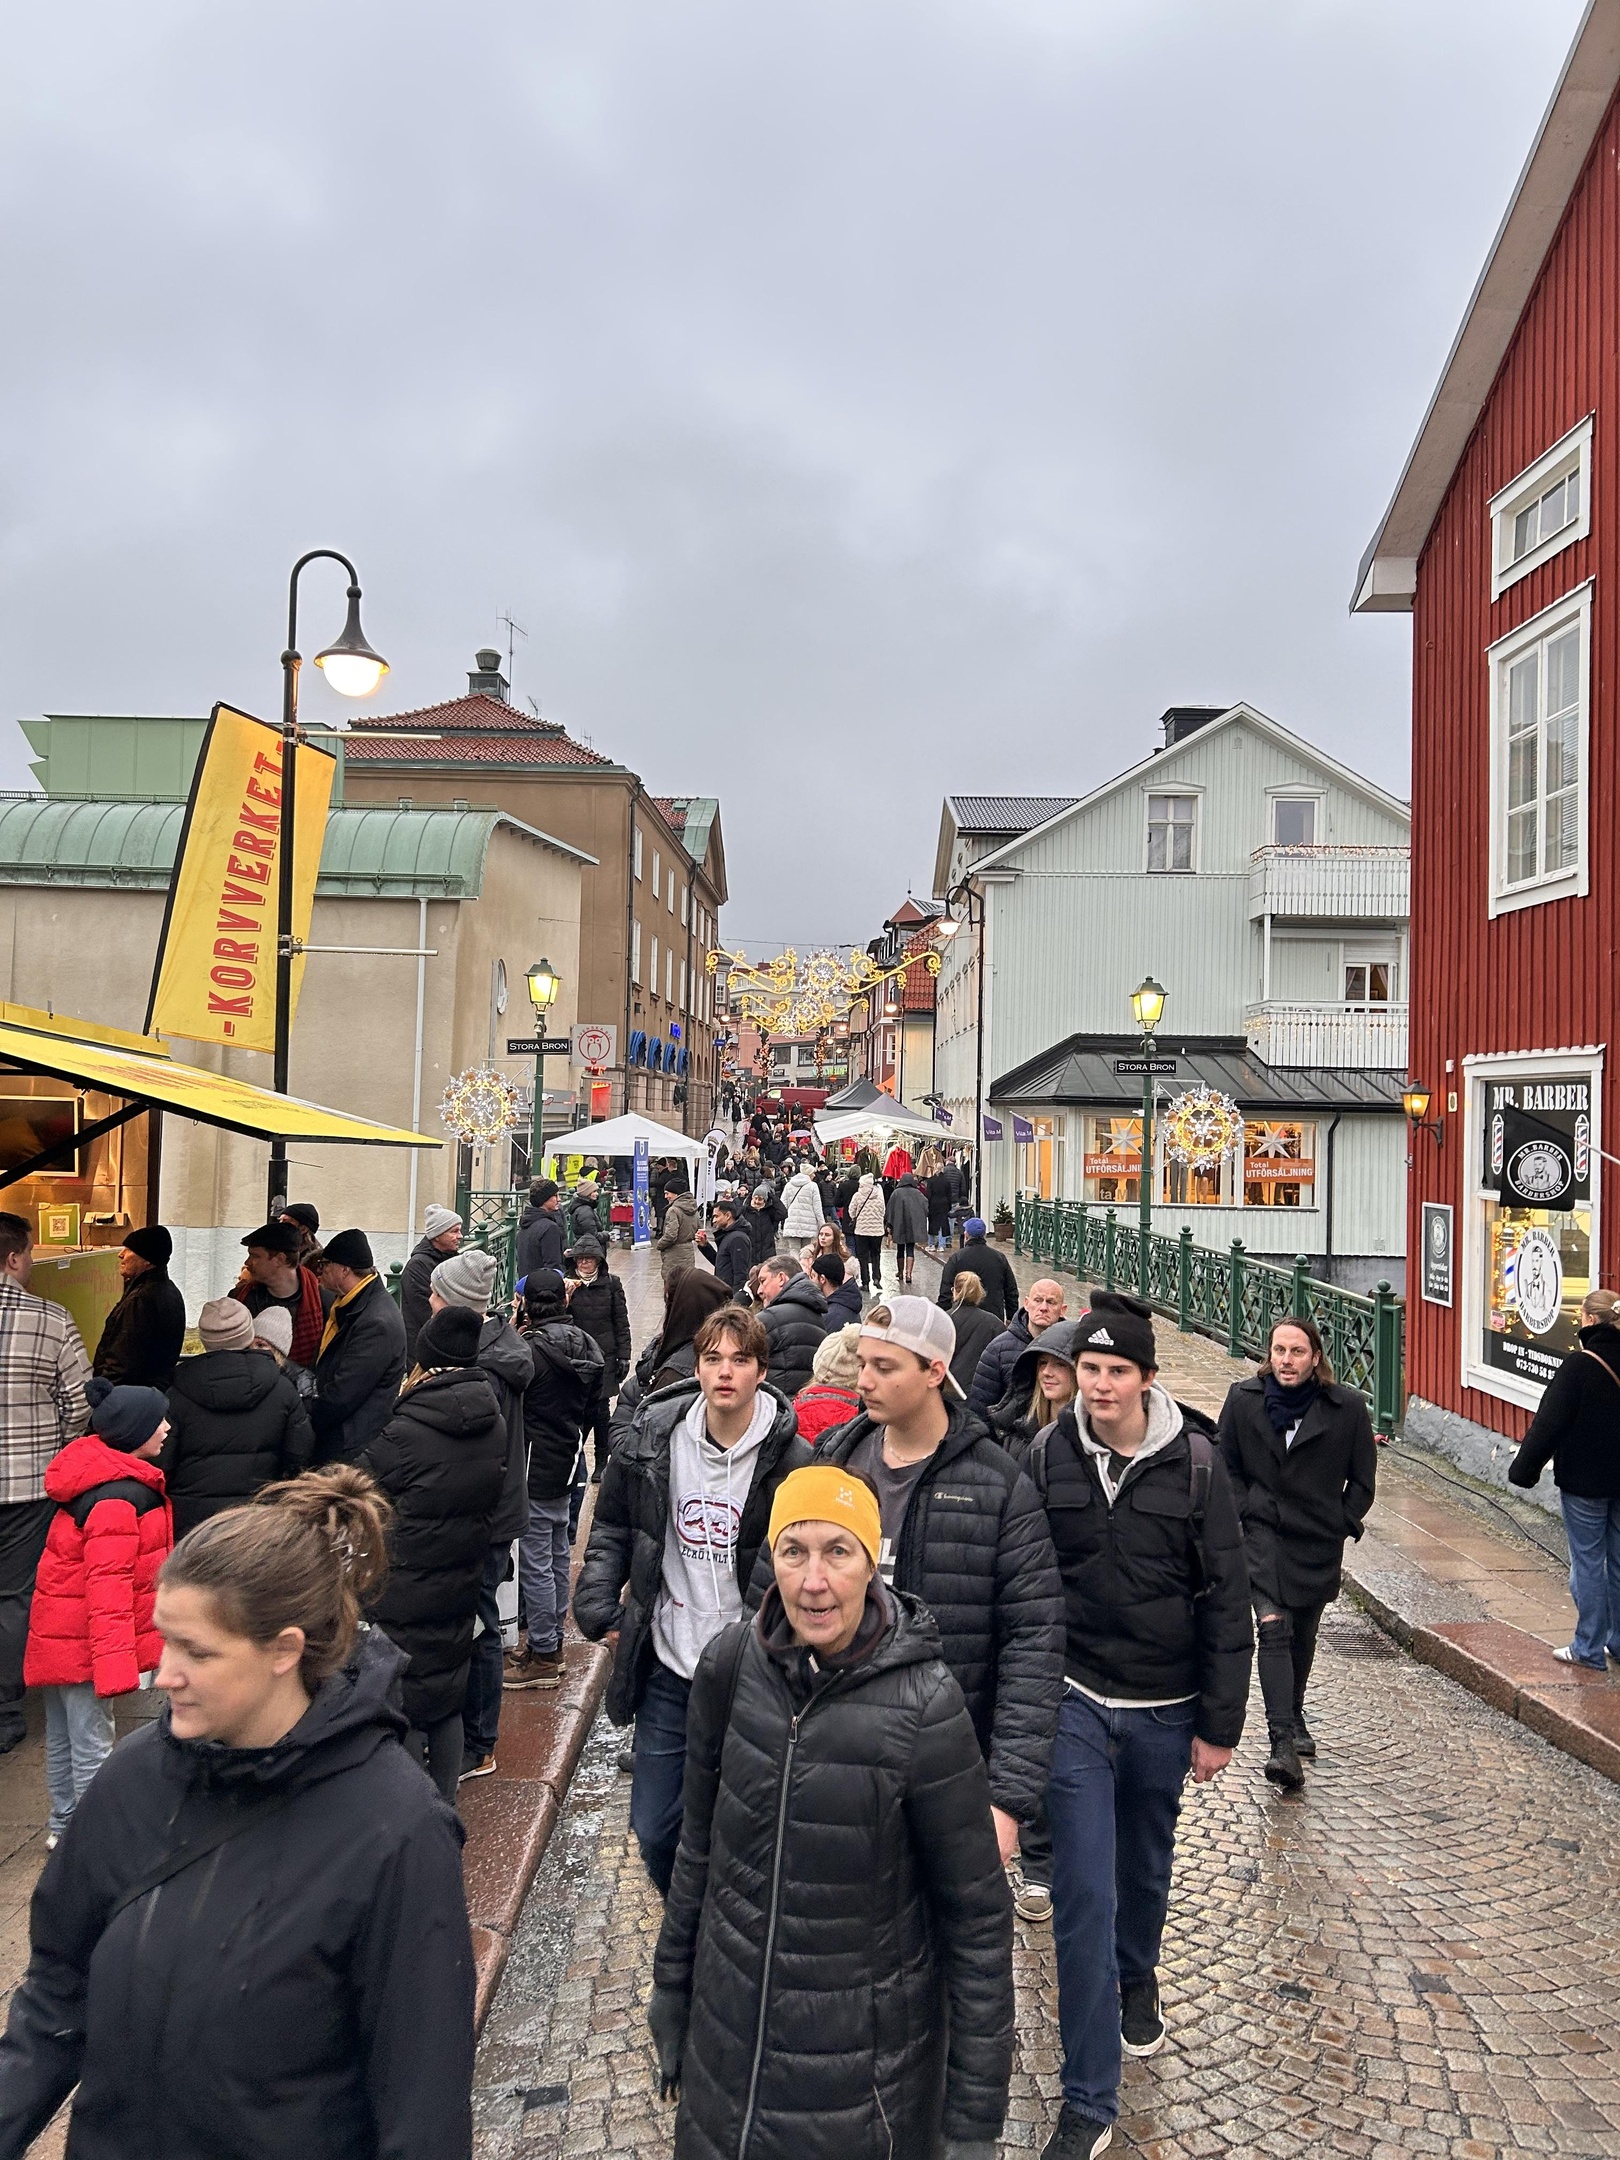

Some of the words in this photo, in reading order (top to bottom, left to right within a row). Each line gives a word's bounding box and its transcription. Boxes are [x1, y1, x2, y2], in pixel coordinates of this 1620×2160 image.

[509, 1042, 540, 1050] STORA
[541, 1042, 568, 1050] BRON
[1118, 1063, 1148, 1071] STORA
[1149, 1063, 1175, 1071] BRON
[1492, 1086, 1519, 1110] MR.
[1522, 1084, 1589, 1111] BARBER
[1532, 1144, 1563, 1161] BARBER
[1085, 1163, 1142, 1174] UTFÖRSÄLJNI
[1246, 1166, 1313, 1178] UTFÖRSÄLJNING
[1514, 1179, 1565, 1199] BARBERSHOP
